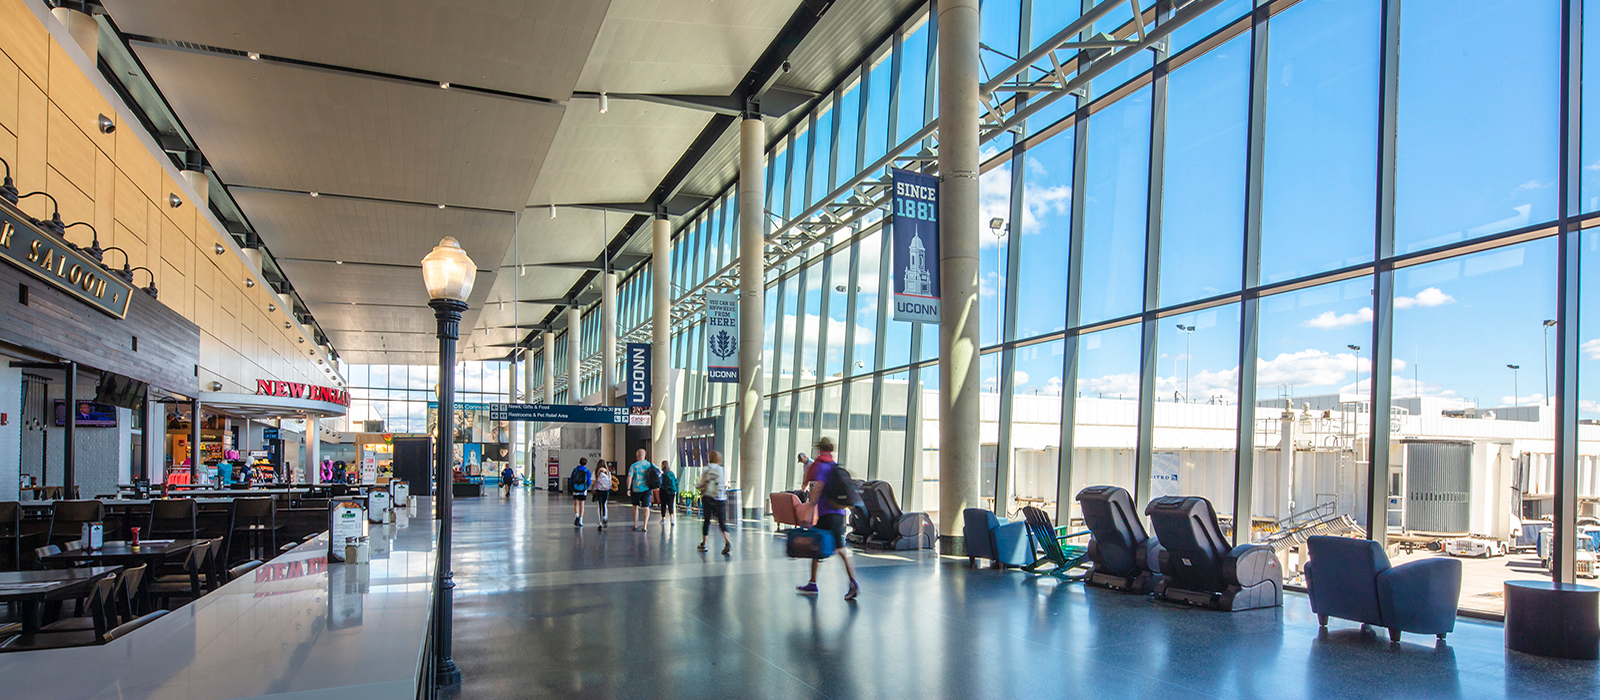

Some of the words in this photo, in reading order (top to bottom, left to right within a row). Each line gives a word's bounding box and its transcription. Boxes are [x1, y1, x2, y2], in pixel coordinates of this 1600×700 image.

[896, 181, 936, 202] SINCE
[896, 197, 937, 223] 1881
[27, 238, 107, 299] SALOON
[897, 301, 938, 316] UCONN
[709, 316, 736, 327] HERE
[632, 348, 646, 403] UCONN
[709, 370, 737, 378] UCONN
[255, 379, 307, 398] NEW
